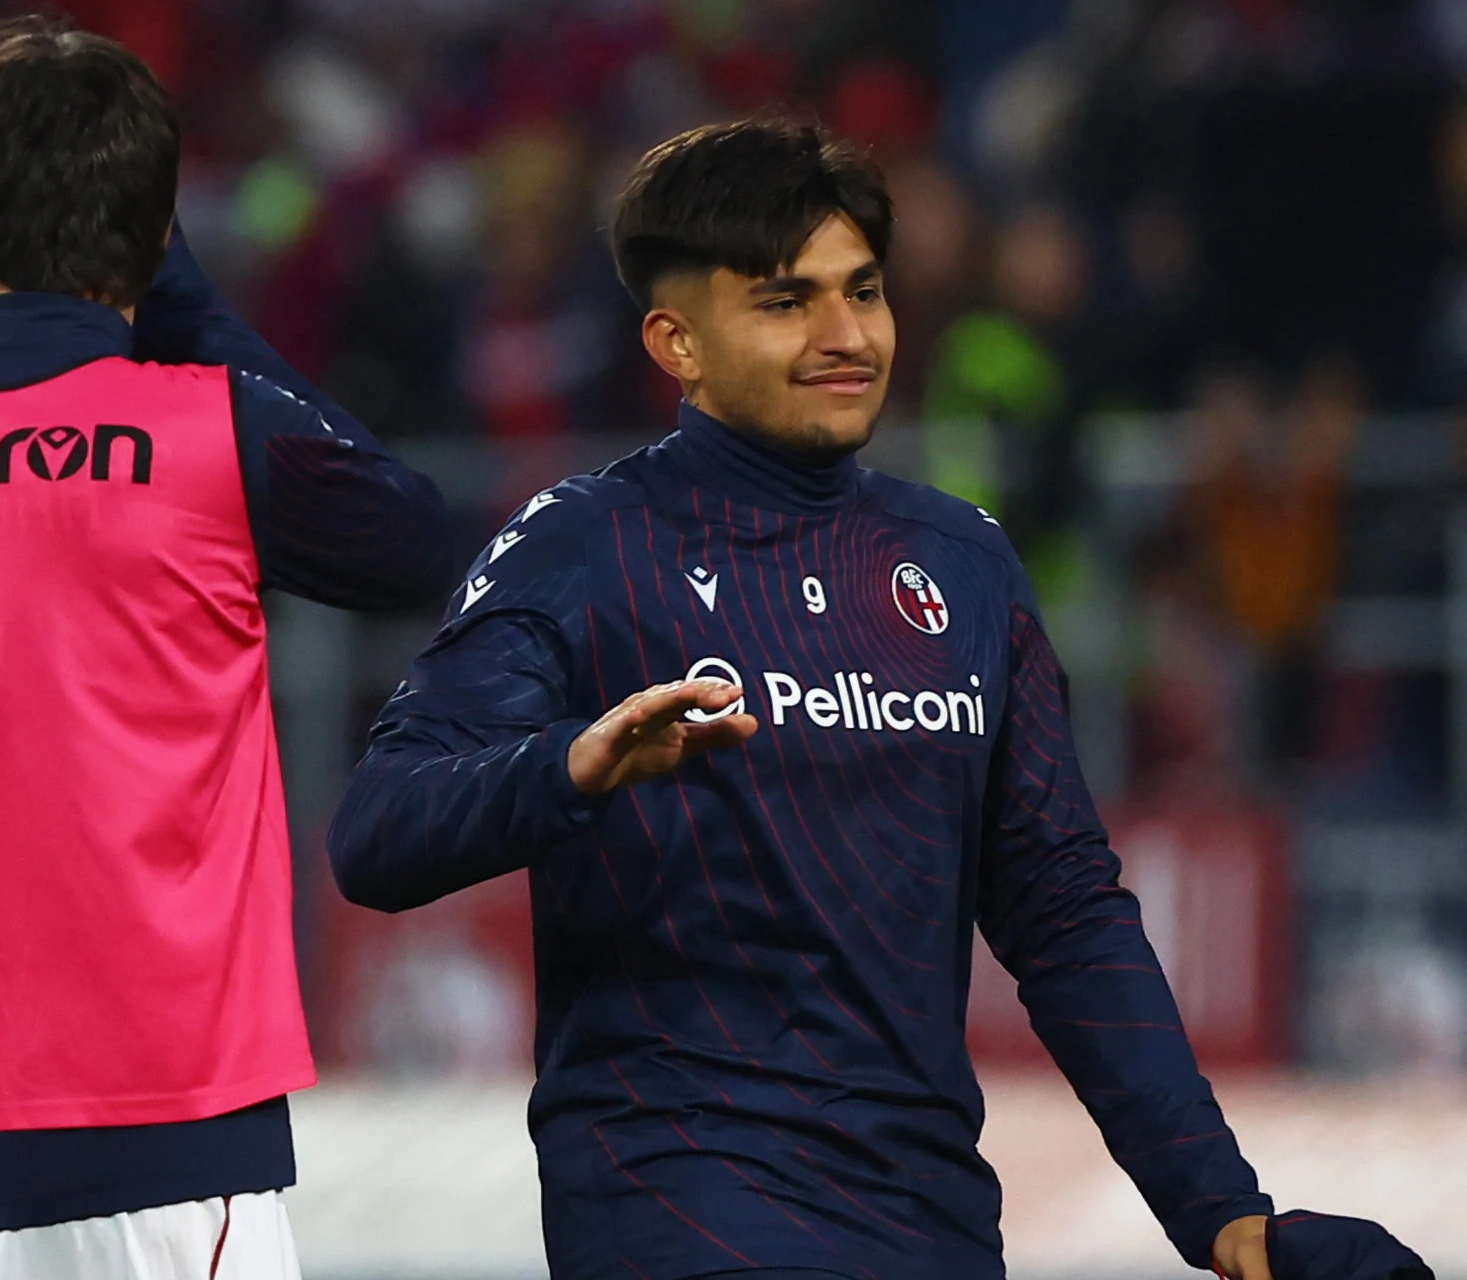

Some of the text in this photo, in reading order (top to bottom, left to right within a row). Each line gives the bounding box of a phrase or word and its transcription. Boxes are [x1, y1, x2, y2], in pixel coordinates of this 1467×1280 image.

[802, 576, 827, 614] 9
[900, 569, 924, 584] BFC
[763, 671, 985, 737] Pelliconi
